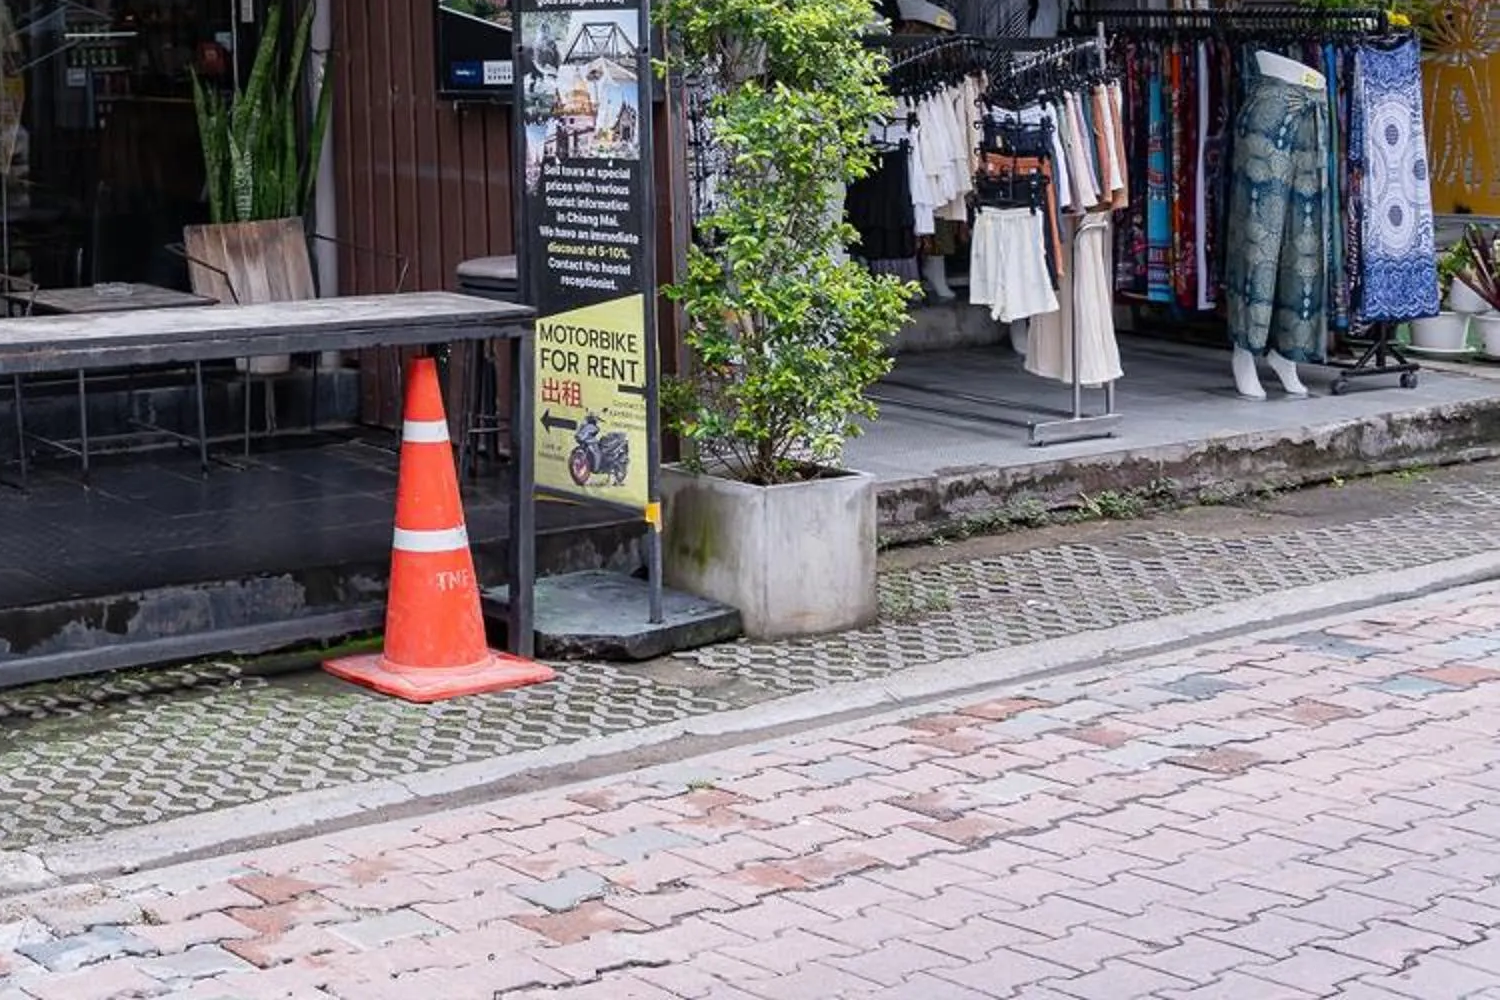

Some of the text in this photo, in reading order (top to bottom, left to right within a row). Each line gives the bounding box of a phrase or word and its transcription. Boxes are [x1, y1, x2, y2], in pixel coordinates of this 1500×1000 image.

[544, 163, 631, 180] Sell tours at special
[545, 180, 630, 195] prices with various
[546, 195, 630, 211] tourist information
[567, 210, 599, 228] Chiang
[539, 225, 639, 244] We have an immediate
[547, 241, 585, 255] discount
[547, 256, 631, 276] Contact the hostel
[540, 323, 637, 353] MOTORBIKE
[541, 347, 639, 382] FOR RENT
[542, 377, 583, 408] 出租
